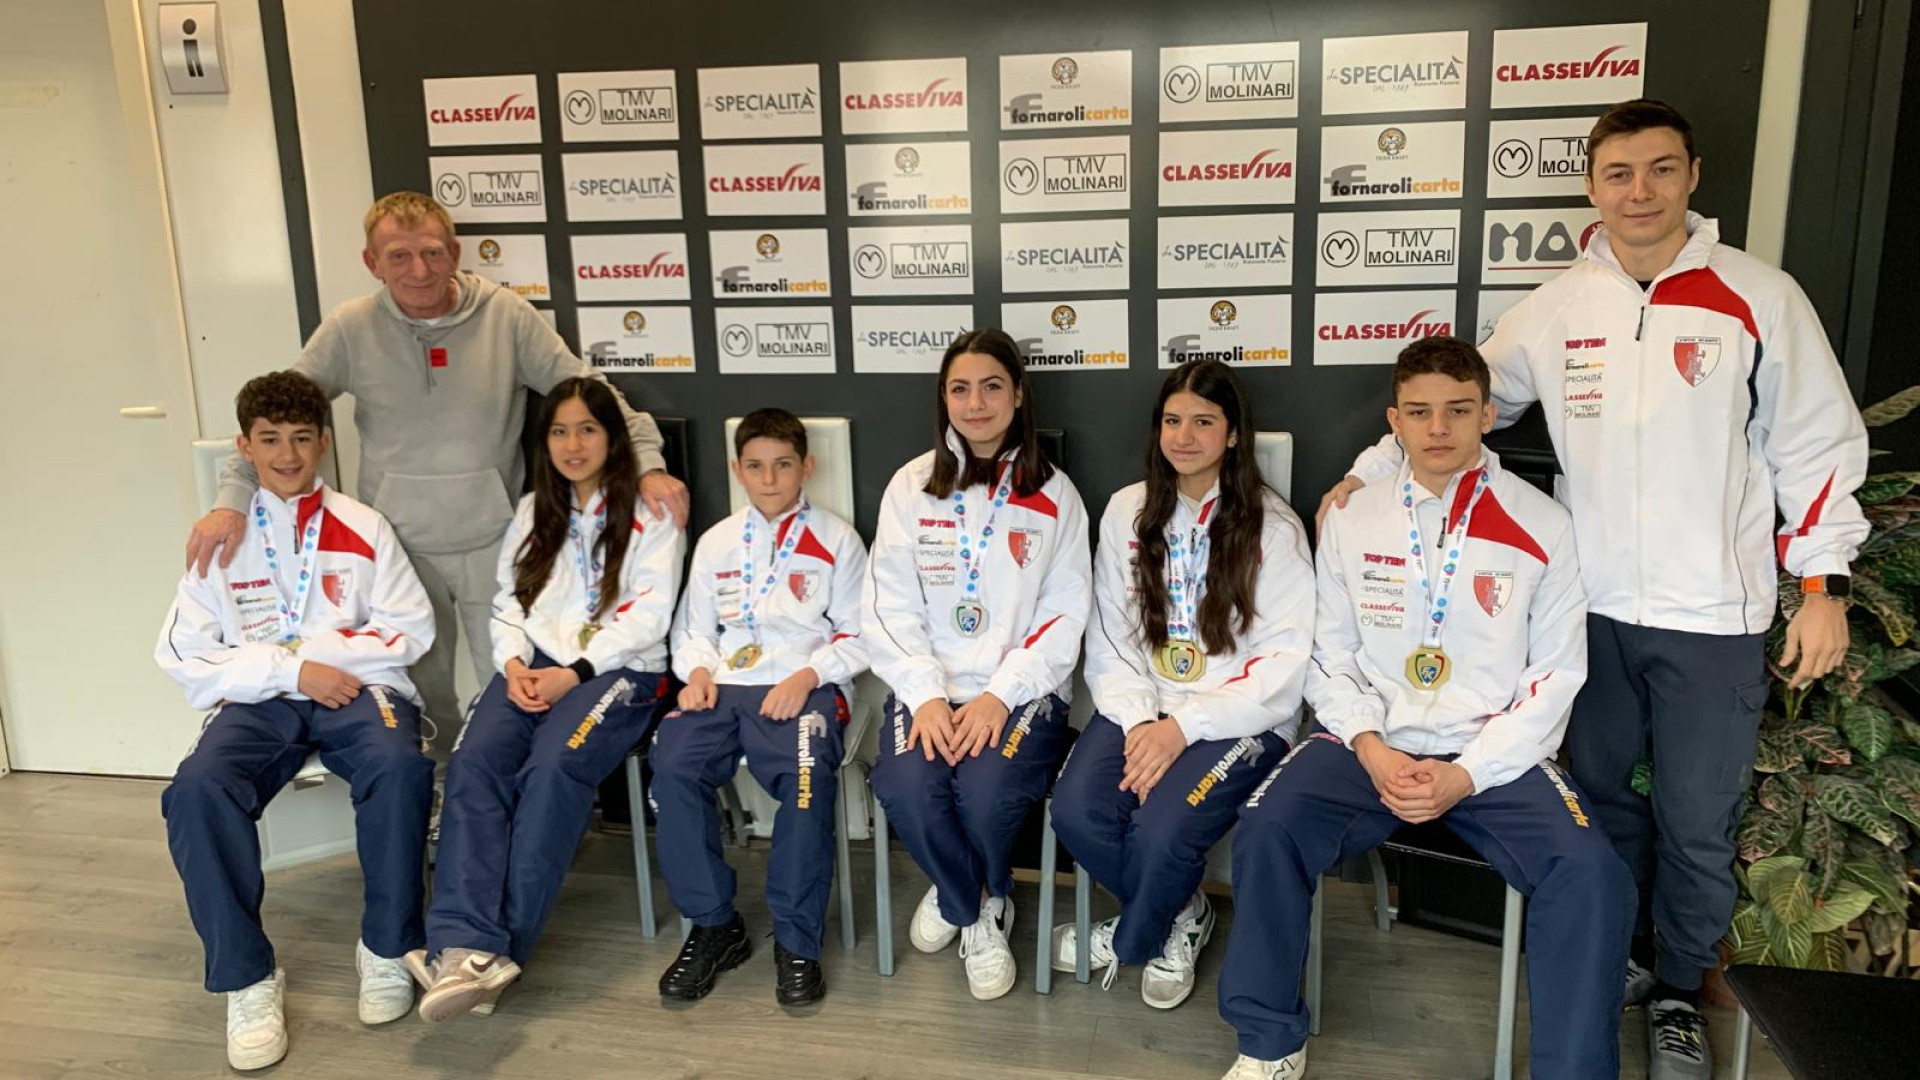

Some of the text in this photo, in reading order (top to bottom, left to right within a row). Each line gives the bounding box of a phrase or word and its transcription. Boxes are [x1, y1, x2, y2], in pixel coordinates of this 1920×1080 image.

[1228, 63, 1273, 82] TMV
[1340, 55, 1464, 85] SPECIALITÀ
[1496, 45, 1640, 82] CLASSEVIVA
[616, 90, 654, 106] TMV
[715, 87, 816, 112] SPECIALITÀ
[845, 78, 963, 109] CLASSEVIVA
[1210, 84, 1290, 98] MOLINARI
[430, 94, 536, 123] CLASSEVIVA
[604, 108, 671, 121] MOLINARI
[1562, 138, 1588, 157] TM
[1063, 156, 1105, 174] TMV
[1163, 149, 1291, 181] CLASSEVIVA
[1542, 159, 1585, 174] MOLI
[486, 172, 522, 189] TMV
[579, 172, 676, 196] SPECIALITÀ
[709, 163, 821, 192] CLASSEVIVA
[1047, 176, 1123, 191] MOLINARI
[474, 191, 538, 203] MOLINARI
[1174, 234, 1289, 261] SPECIALITÀ
[1386, 230, 1433, 247] TMV
[910, 244, 949, 260] TMV
[1017, 240, 1126, 266] SPECIALITÀ
[1368, 250, 1450, 264] MOLINARI
[578, 251, 685, 279] CLASSEVIVA
[894, 263, 965, 275] MOLINARI
[773, 324, 811, 340] TMV
[1318, 309, 1451, 340] CLASSEVIVA
[760, 342, 827, 354] MOLINARI
[1021, 350, 1127, 366] ornarolicarta
